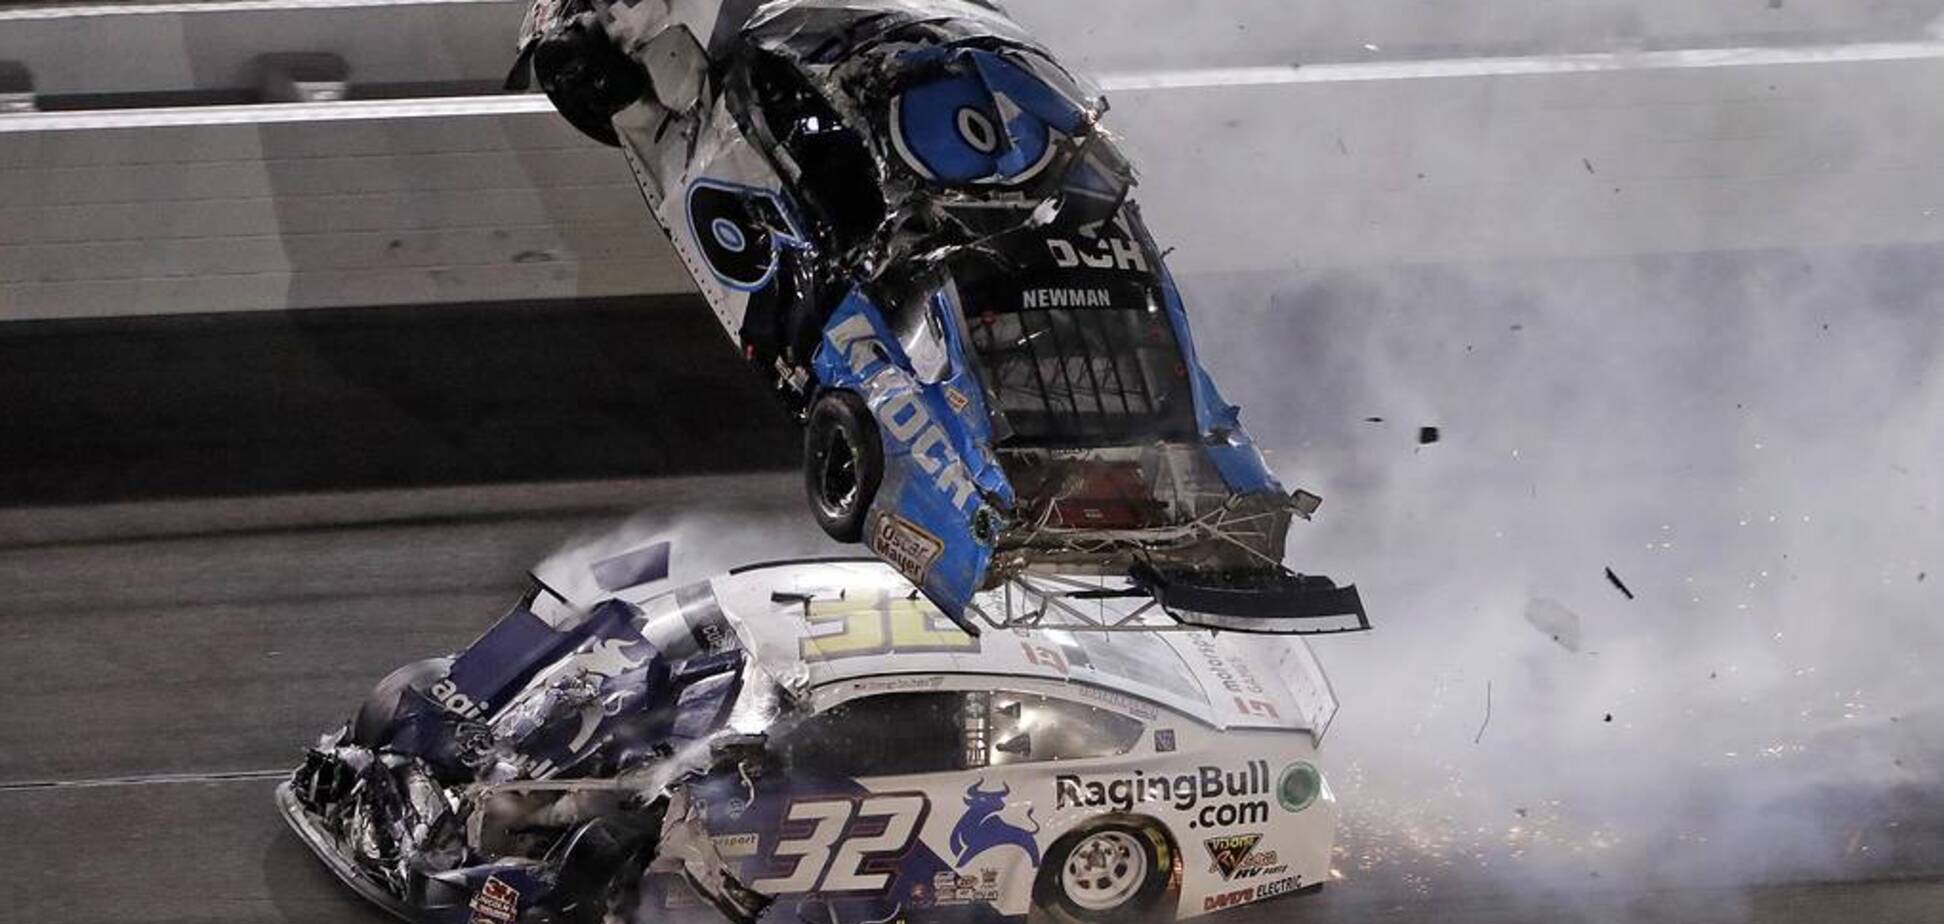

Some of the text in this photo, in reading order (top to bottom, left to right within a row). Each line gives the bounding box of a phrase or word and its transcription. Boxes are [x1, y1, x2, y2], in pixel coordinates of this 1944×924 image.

[1022, 288, 1111, 309] NEWMAN
[877, 536, 922, 577] Mayer
[1056, 759, 1270, 812] RagingBull
[1189, 800, 1269, 829] .com
[752, 797, 926, 894] 32
[1257, 875, 1302, 897] ELECTRIC
